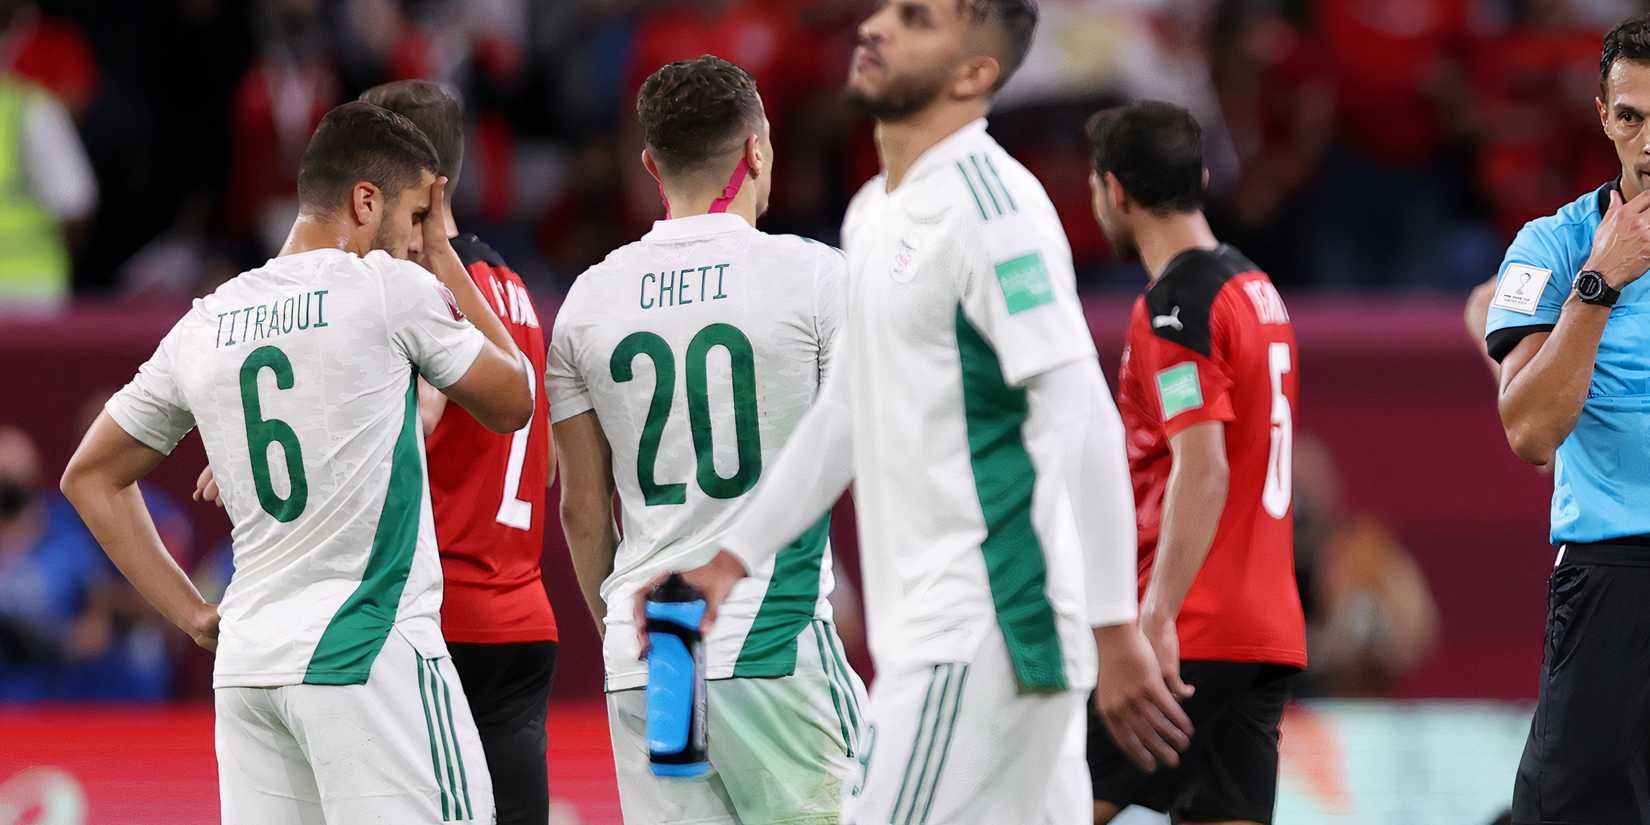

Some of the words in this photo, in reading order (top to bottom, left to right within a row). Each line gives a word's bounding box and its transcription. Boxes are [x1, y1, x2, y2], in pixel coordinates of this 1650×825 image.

[216, 290, 328, 348] TITRAOUI
[640, 263, 730, 309] CHETI
[239, 345, 308, 523] 6
[611, 323, 762, 506] 20
